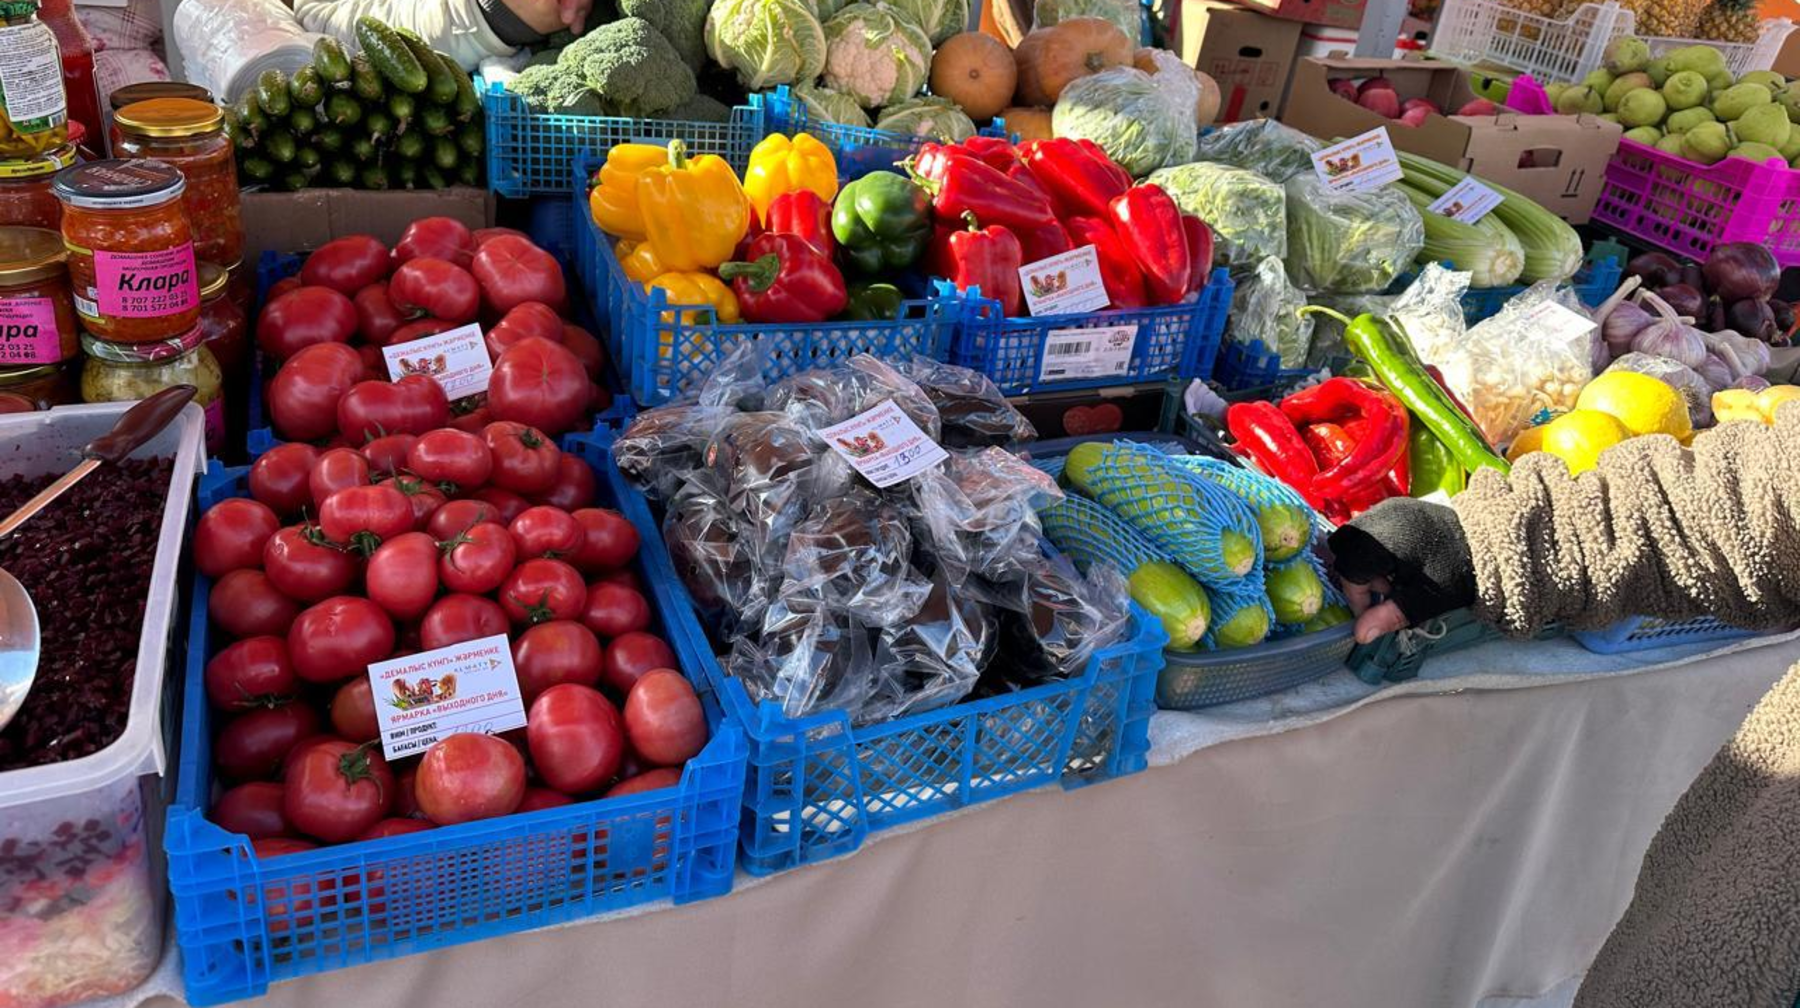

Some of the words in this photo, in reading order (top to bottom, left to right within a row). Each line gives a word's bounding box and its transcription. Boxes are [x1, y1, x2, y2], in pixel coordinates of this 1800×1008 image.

[118, 270, 189, 292] Клара
[131, 296, 148, 304] 707
[131, 304, 148, 313] 701
[389, 710, 431, 724] ЯРМАРКА
